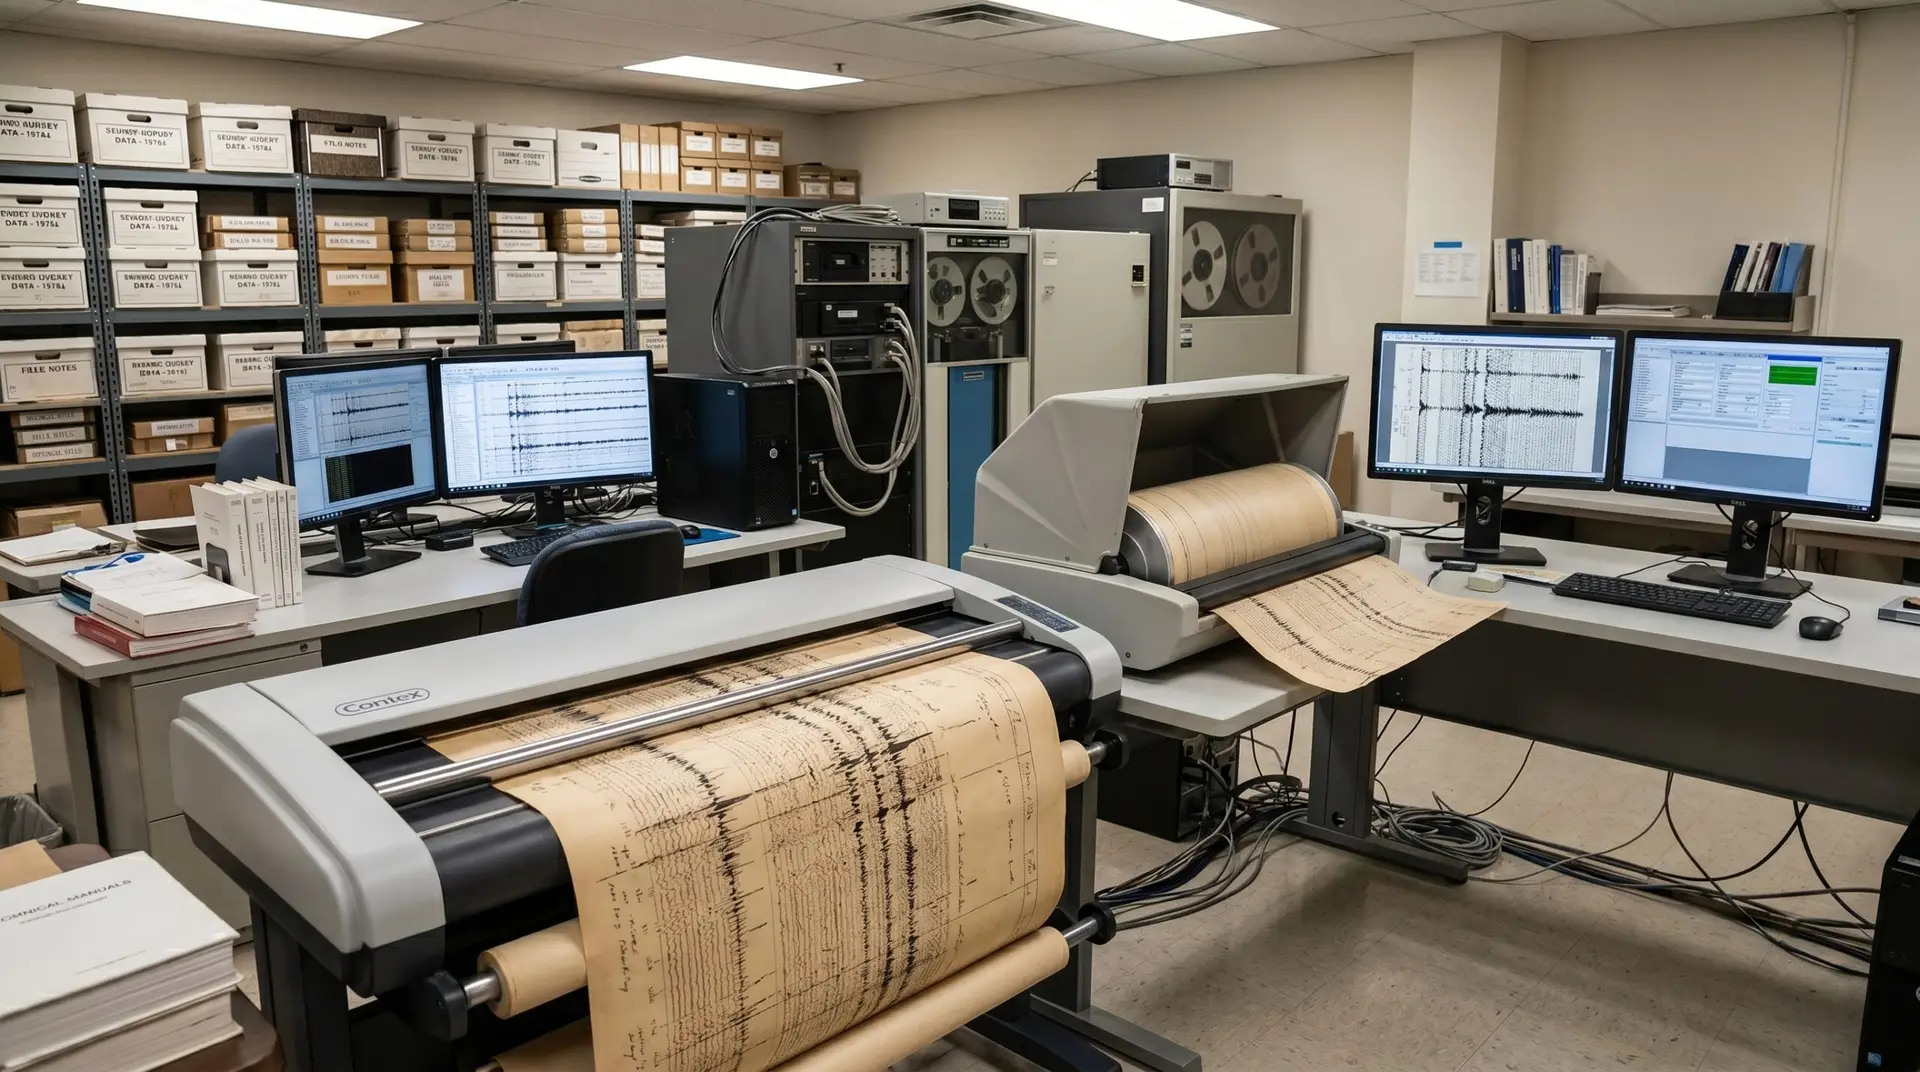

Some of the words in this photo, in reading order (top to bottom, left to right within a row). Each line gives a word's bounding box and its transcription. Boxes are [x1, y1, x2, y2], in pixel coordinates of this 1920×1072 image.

[114, 136, 137, 144] DATA
[48, 364, 77, 372] NOTES
[343, 690, 423, 713] Contex
[66, 879, 132, 902] MANUALS
